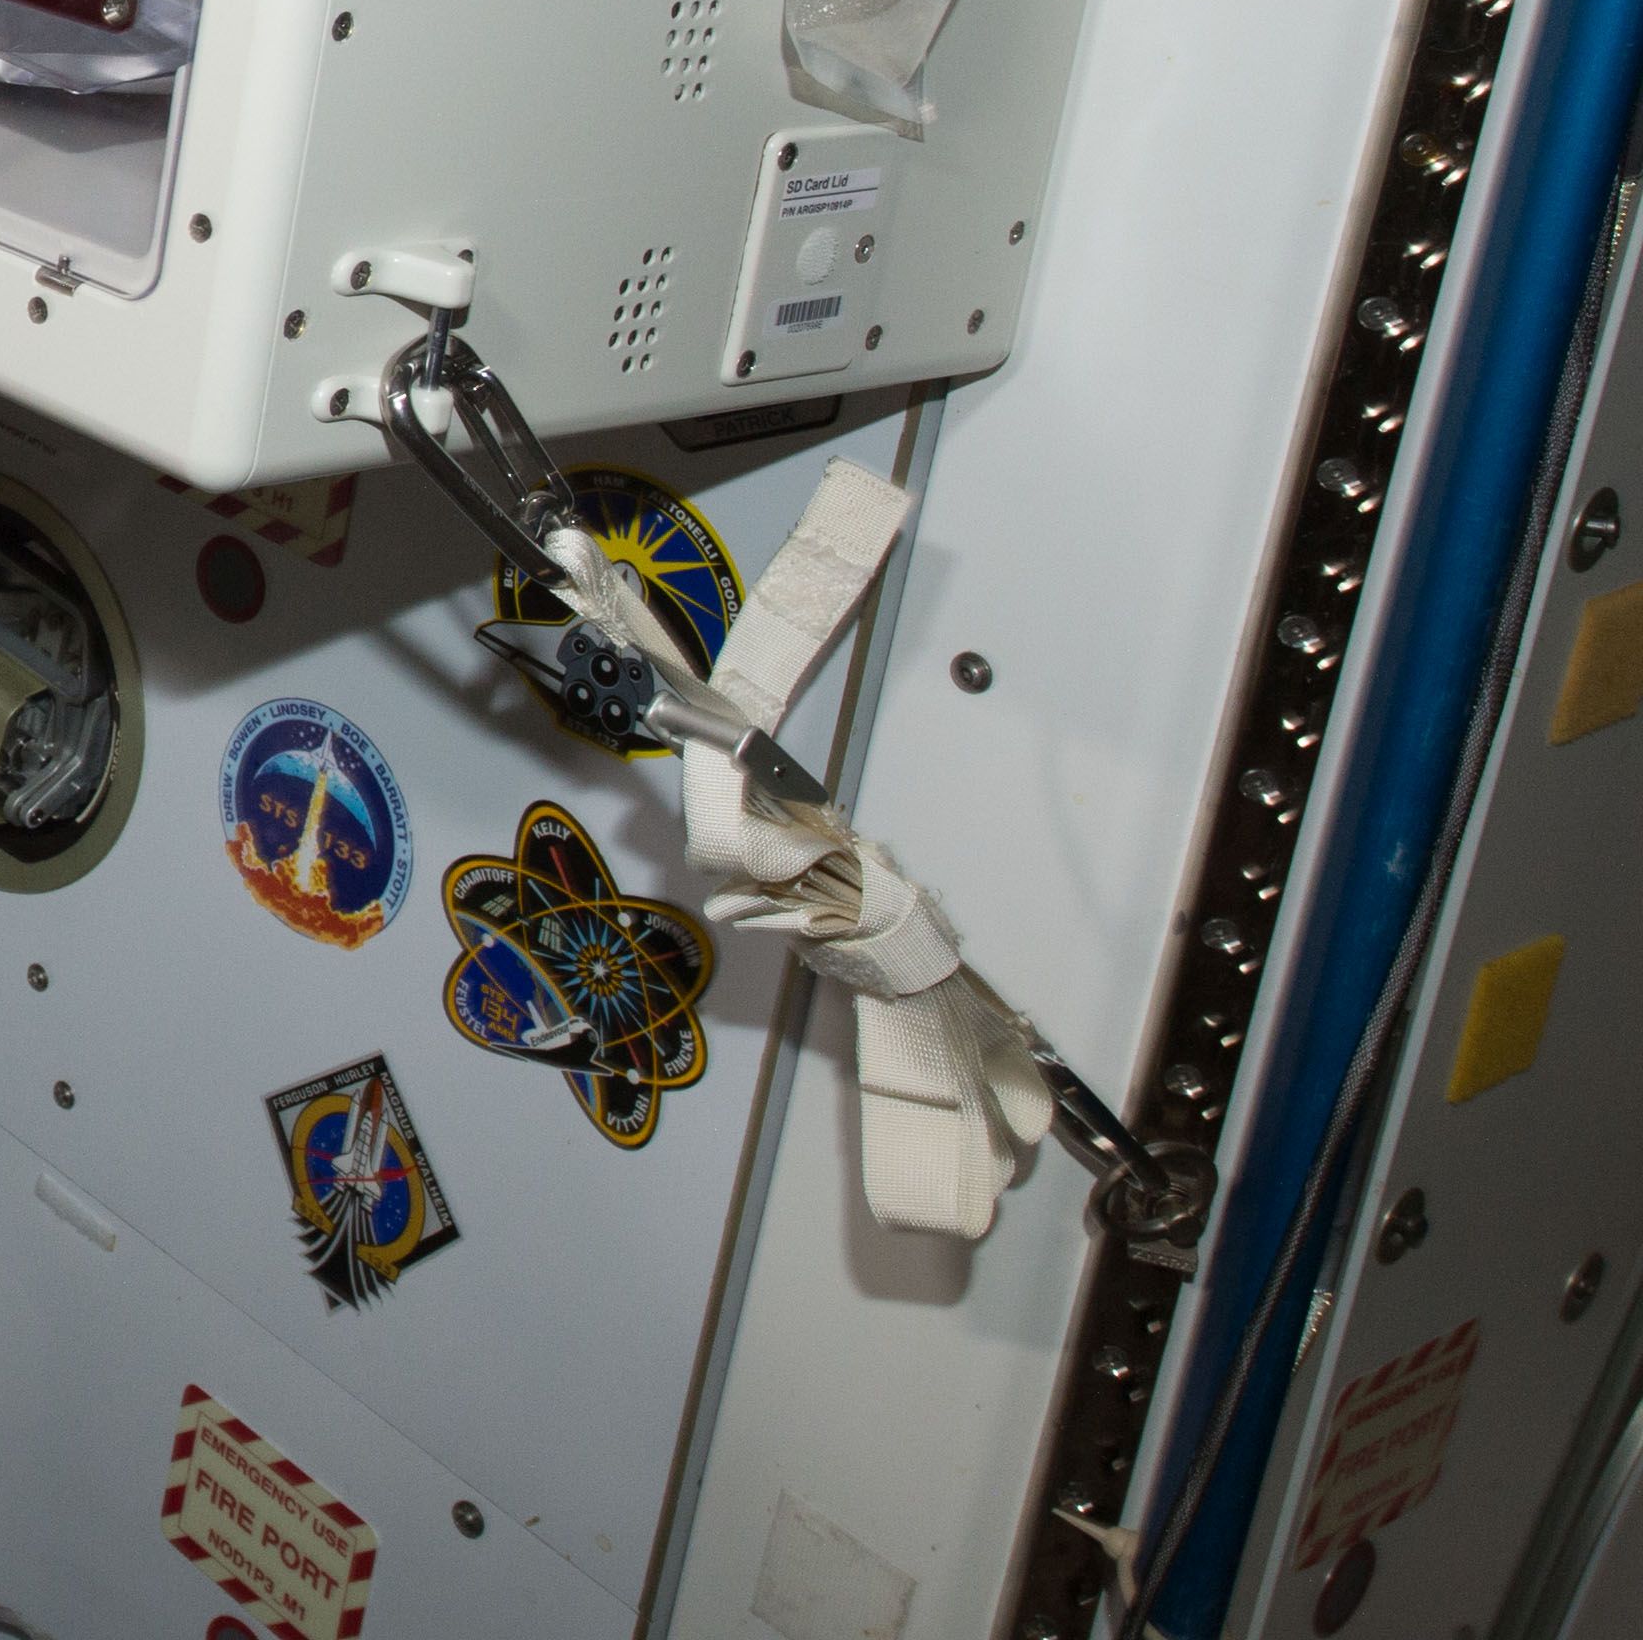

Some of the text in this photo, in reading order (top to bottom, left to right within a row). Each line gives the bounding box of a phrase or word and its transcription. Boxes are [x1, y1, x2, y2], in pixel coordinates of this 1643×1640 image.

[787, 173, 849, 194] SD Card Lid
[713, 410, 797, 438] PATRICK
[647, 489, 719, 561] ANTONELLI
[268, 703, 327, 722] LINDSEY
[229, 716, 263, 761] BOWEN
[340, 722, 370, 755] BOE
[224, 774, 235, 824] DREW
[258, 792, 300, 829] STS
[374, 763, 410, 841] BARRATT
[321, 831, 368, 871] 133
[531, 822, 573, 842] KELLY
[385, 858, 409, 911] STOTT
[453, 867, 516, 901] CHAMITOFF
[455, 978, 490, 1040] FEUSTEL
[664, 1028, 694, 1078] FINCKE
[272, 1062, 376, 1111] FERGUSON HURLEY
[606, 1092, 651, 1134] VITTORI
[380, 1071, 453, 1228] MAGNUS WALHEIM
[201, 1426, 349, 1559] EMERGENCY USE
[195, 1467, 340, 1601] FIRE PORT
